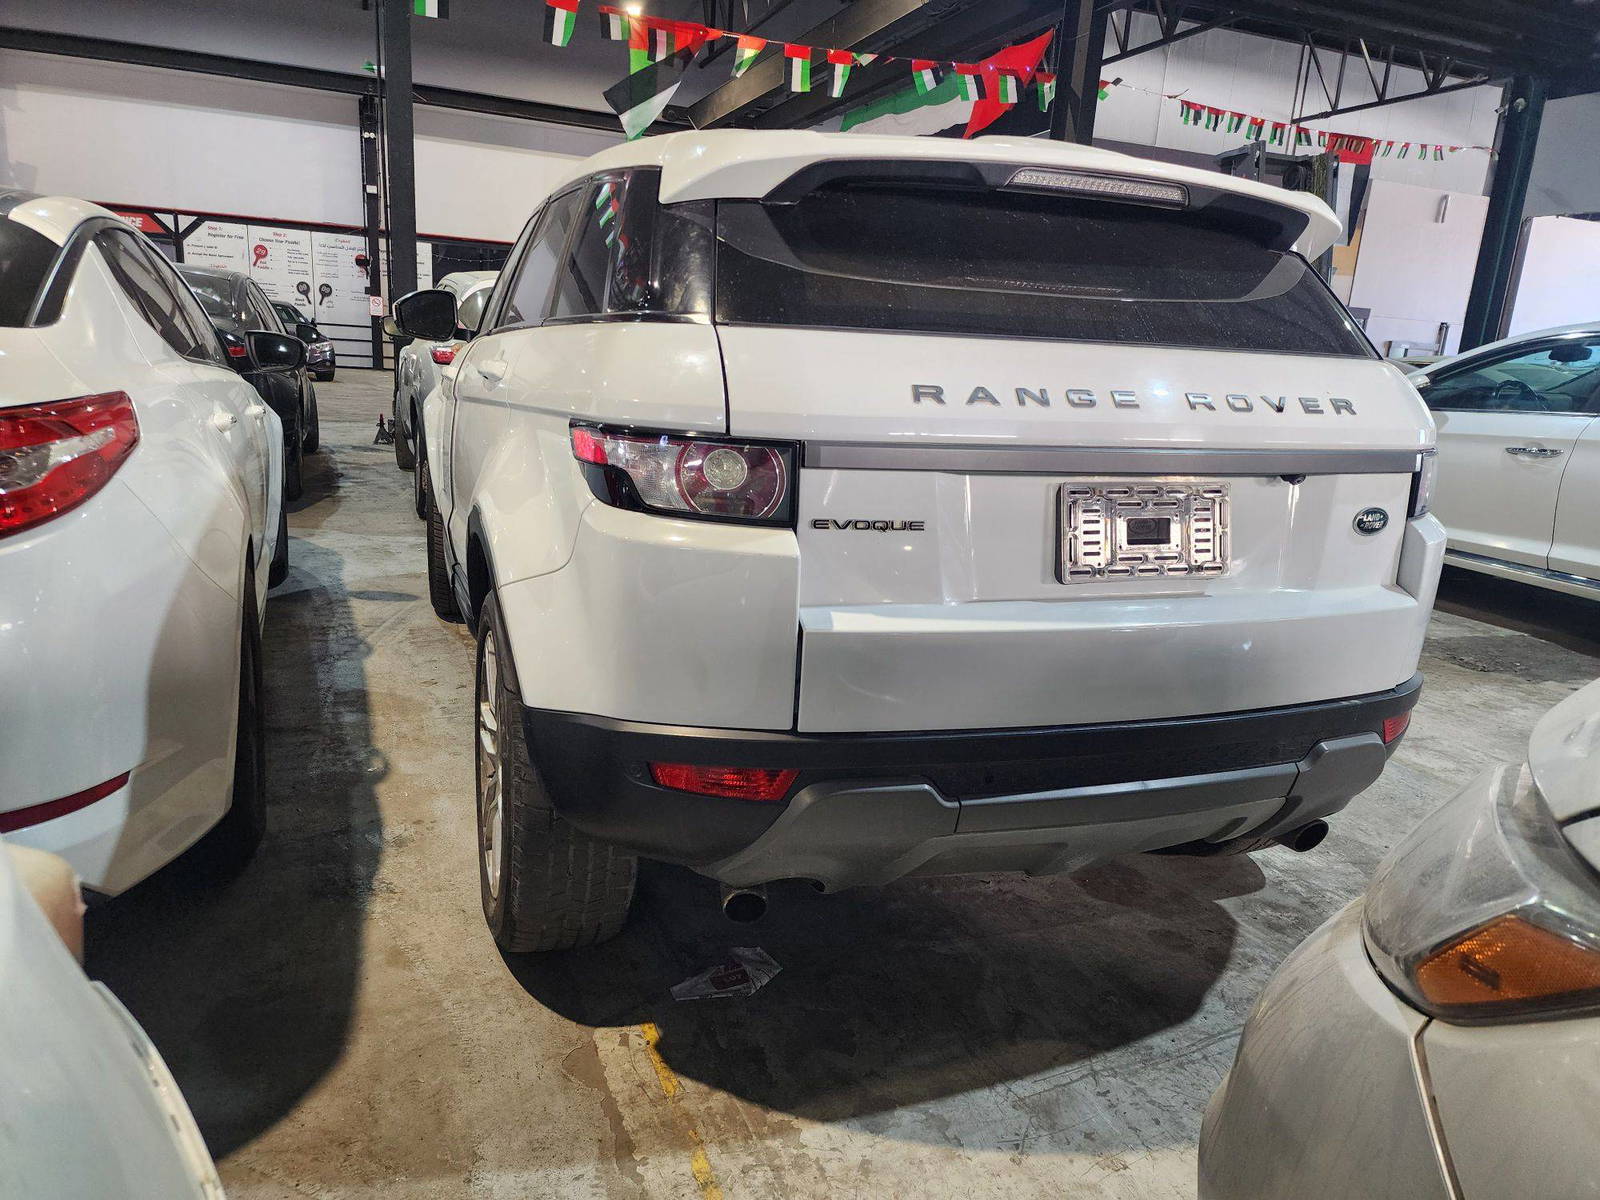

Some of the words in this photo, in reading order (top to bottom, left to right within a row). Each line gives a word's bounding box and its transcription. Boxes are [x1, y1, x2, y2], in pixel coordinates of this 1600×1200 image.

[911, 384, 1141, 409] RANGE
[1184, 391, 1358, 416] ROVER
[1363, 513, 1381, 522] LAND
[811, 518, 926, 532] EVOQUE
